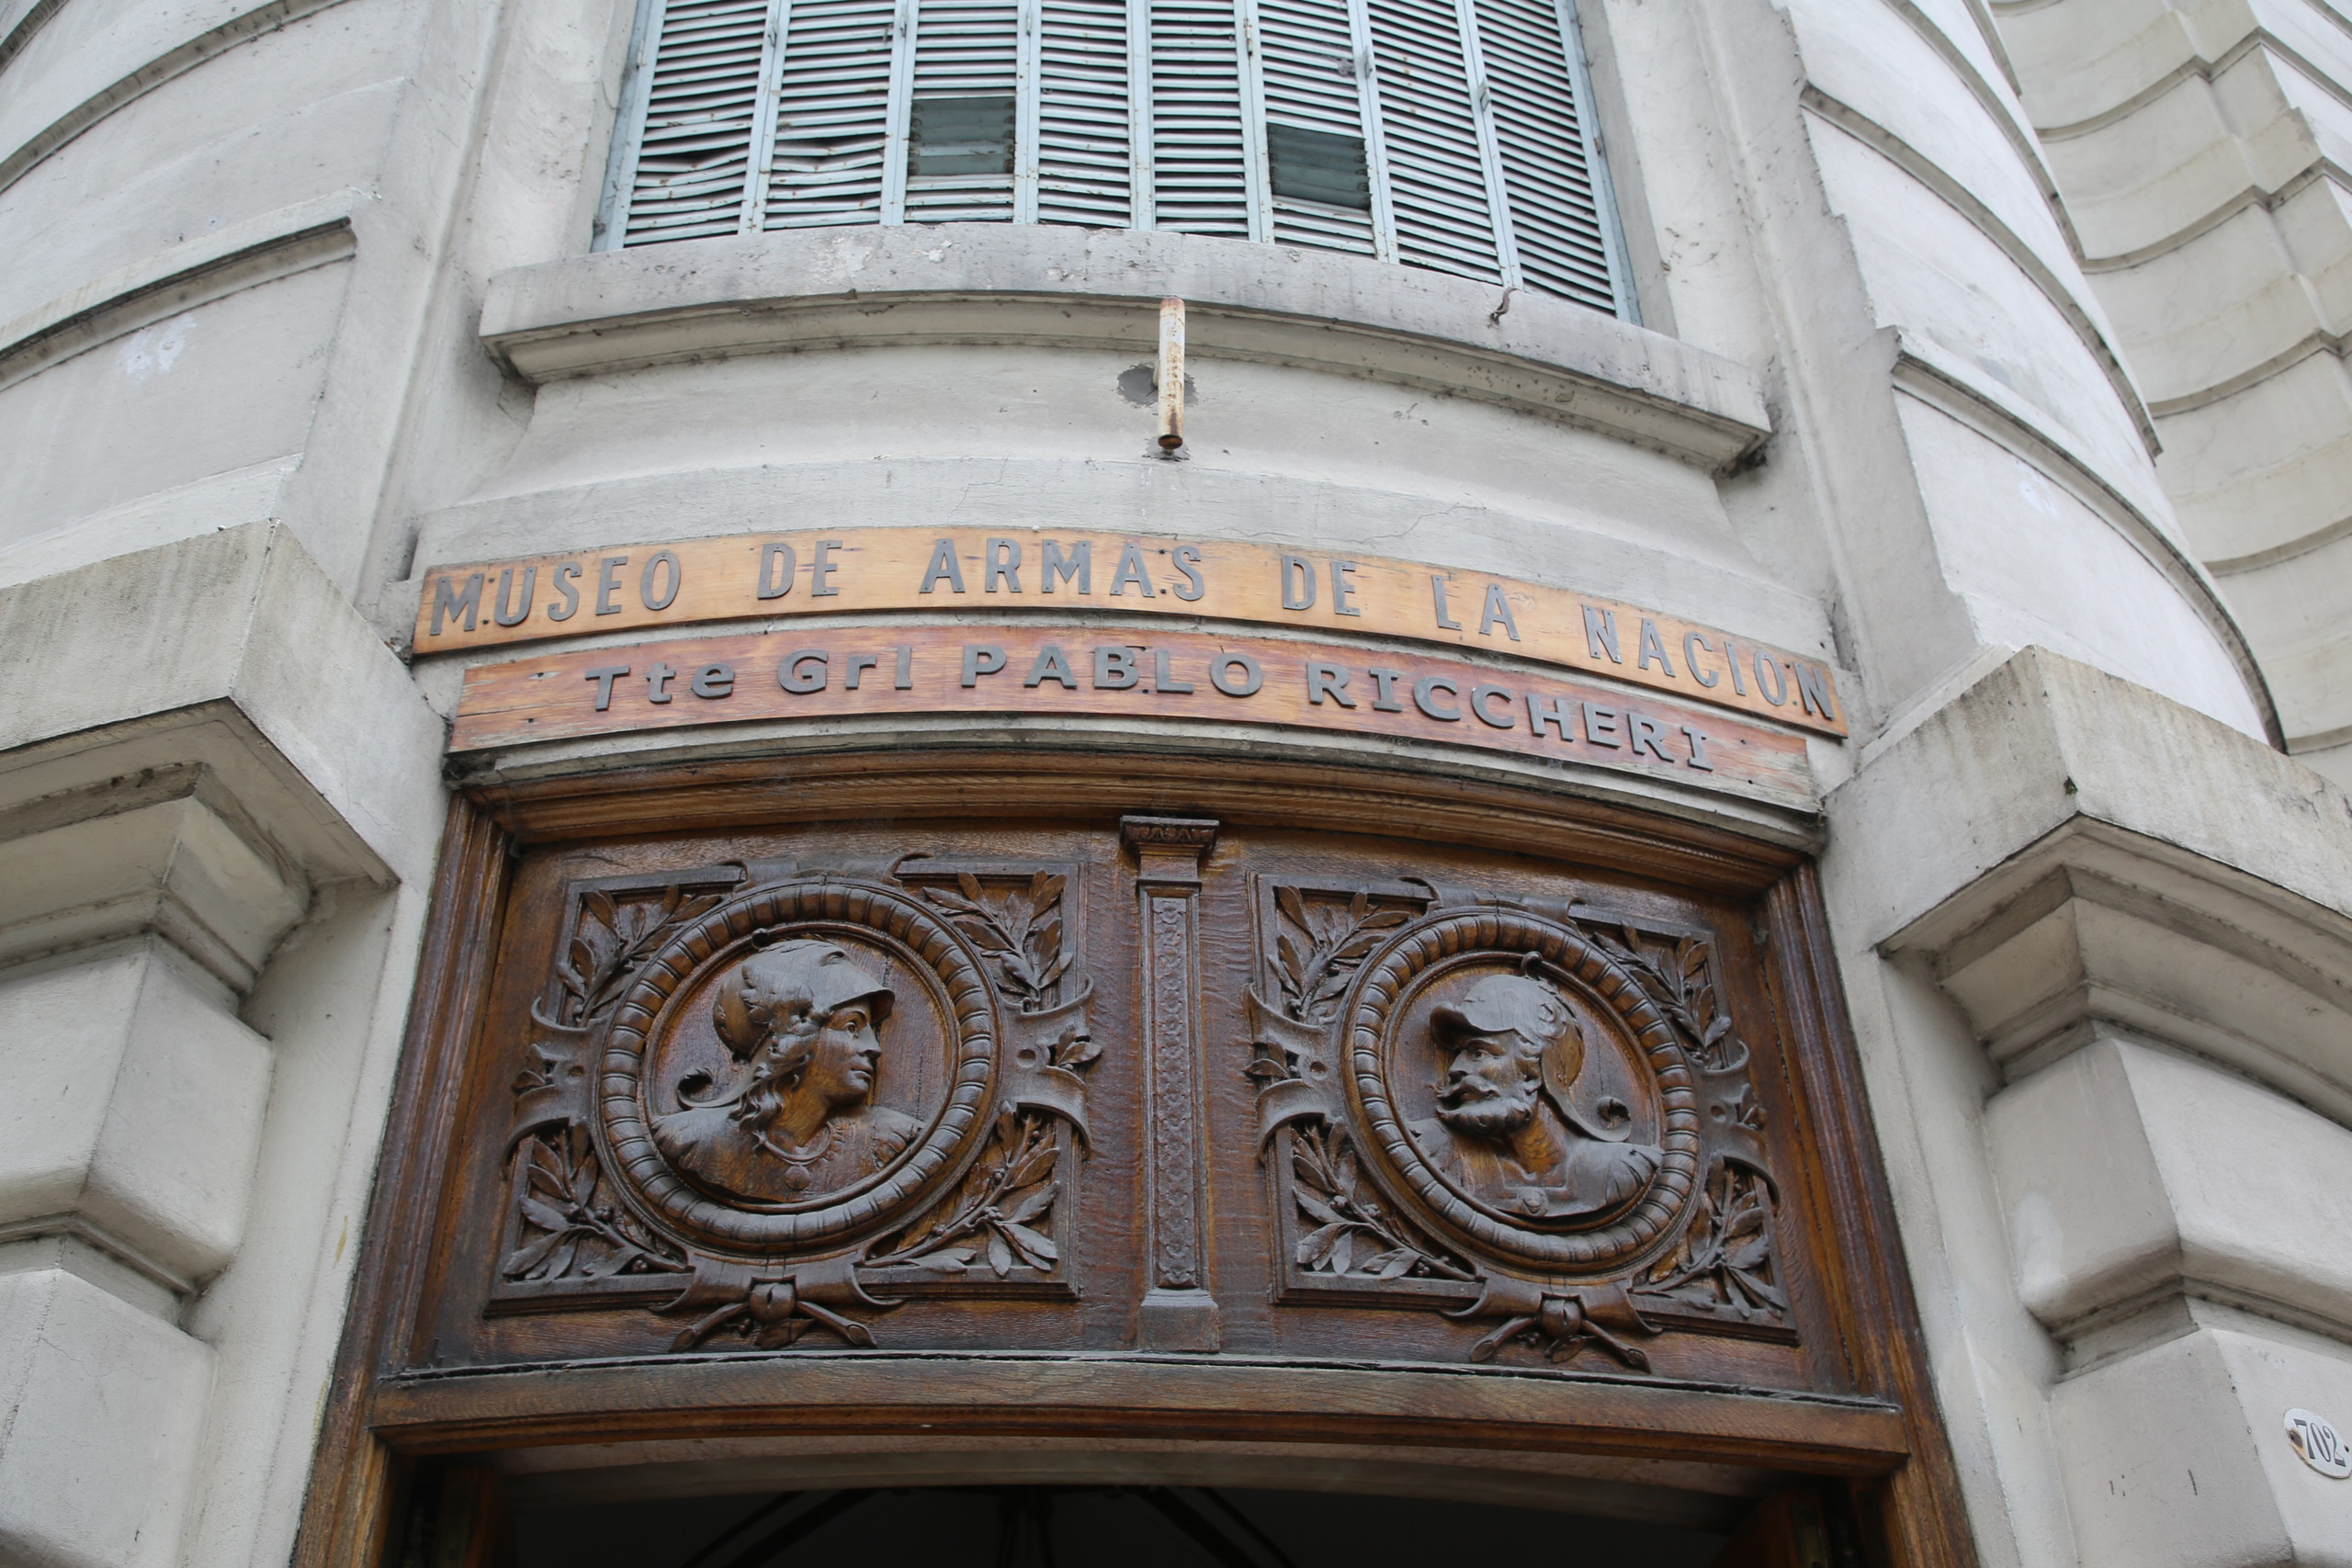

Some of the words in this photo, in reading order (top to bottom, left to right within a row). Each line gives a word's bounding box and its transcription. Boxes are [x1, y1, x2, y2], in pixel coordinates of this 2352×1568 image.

[430, 550, 681, 636] MUSEO
[757, 540, 842, 600] DE
[919, 537, 1204, 601] ARMAS
[1282, 555, 1361, 616] DE
[1431, 574, 1521, 641] LA
[1582, 604, 1835, 720] NACION
[585, 662, 734, 712] Tte
[961, 645, 1263, 698] PABLO
[1306, 661, 1714, 773] RICCHERI
[2293, 1418, 2346, 1468] 702
